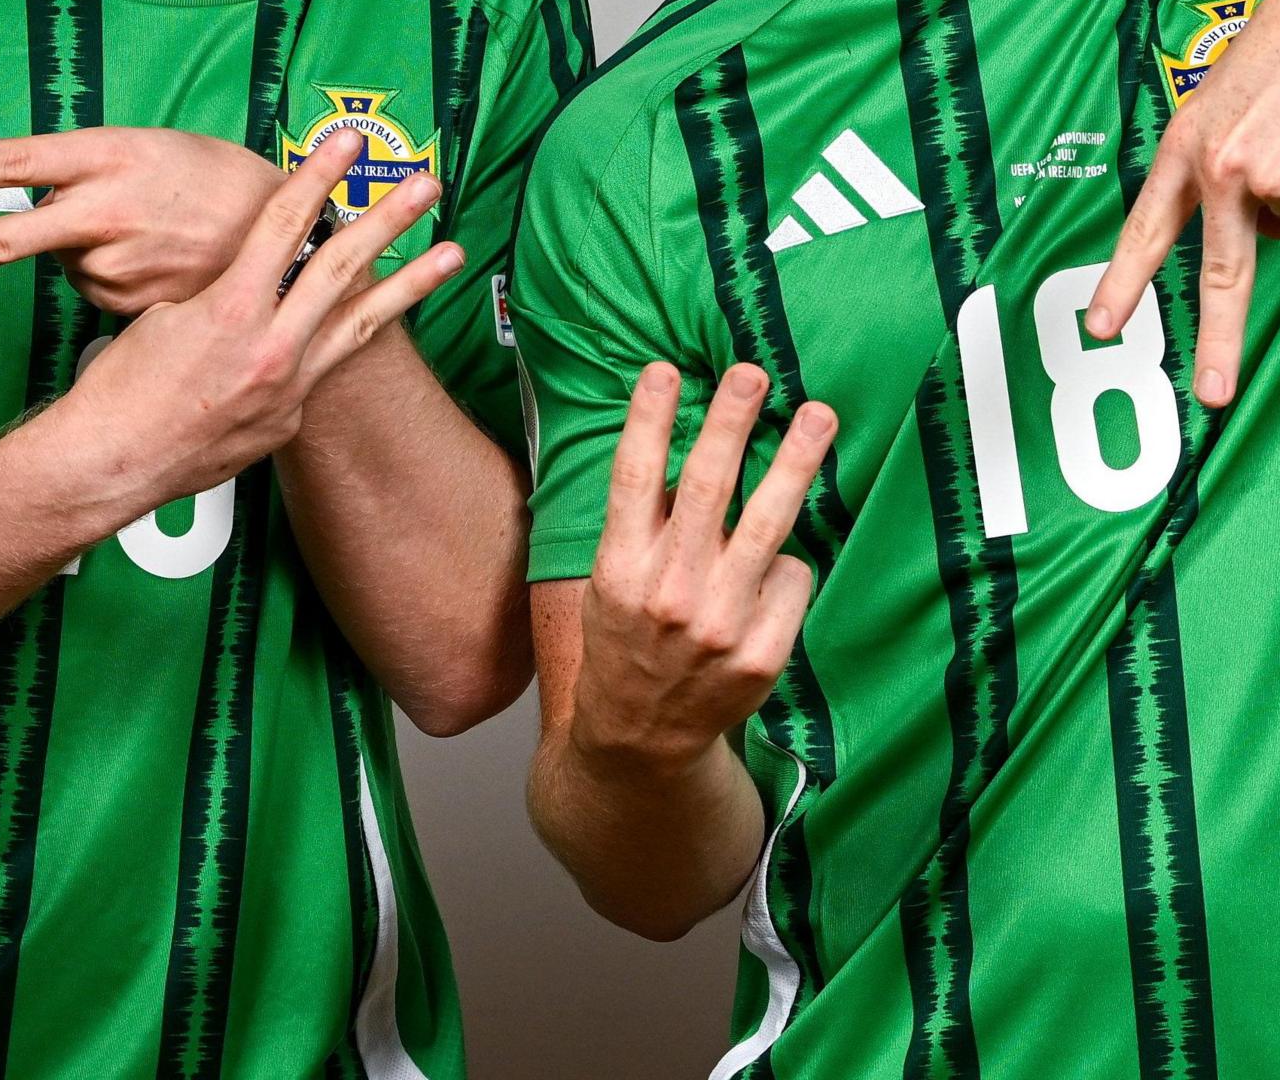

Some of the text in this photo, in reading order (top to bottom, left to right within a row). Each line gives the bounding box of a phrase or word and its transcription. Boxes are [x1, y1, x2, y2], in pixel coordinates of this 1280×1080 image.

[1194, 31, 1220, 60] IRISH
[342, 118, 403, 156] FOOTBALL
[1054, 148, 1078, 162] JULY
[365, 165, 415, 179] IRELAND
[1010, 162, 1036, 177] UEFA
[1047, 165, 1082, 179] IRELAND
[1084, 163, 1108, 178] 2024
[956, 261, 1181, 539] 18
